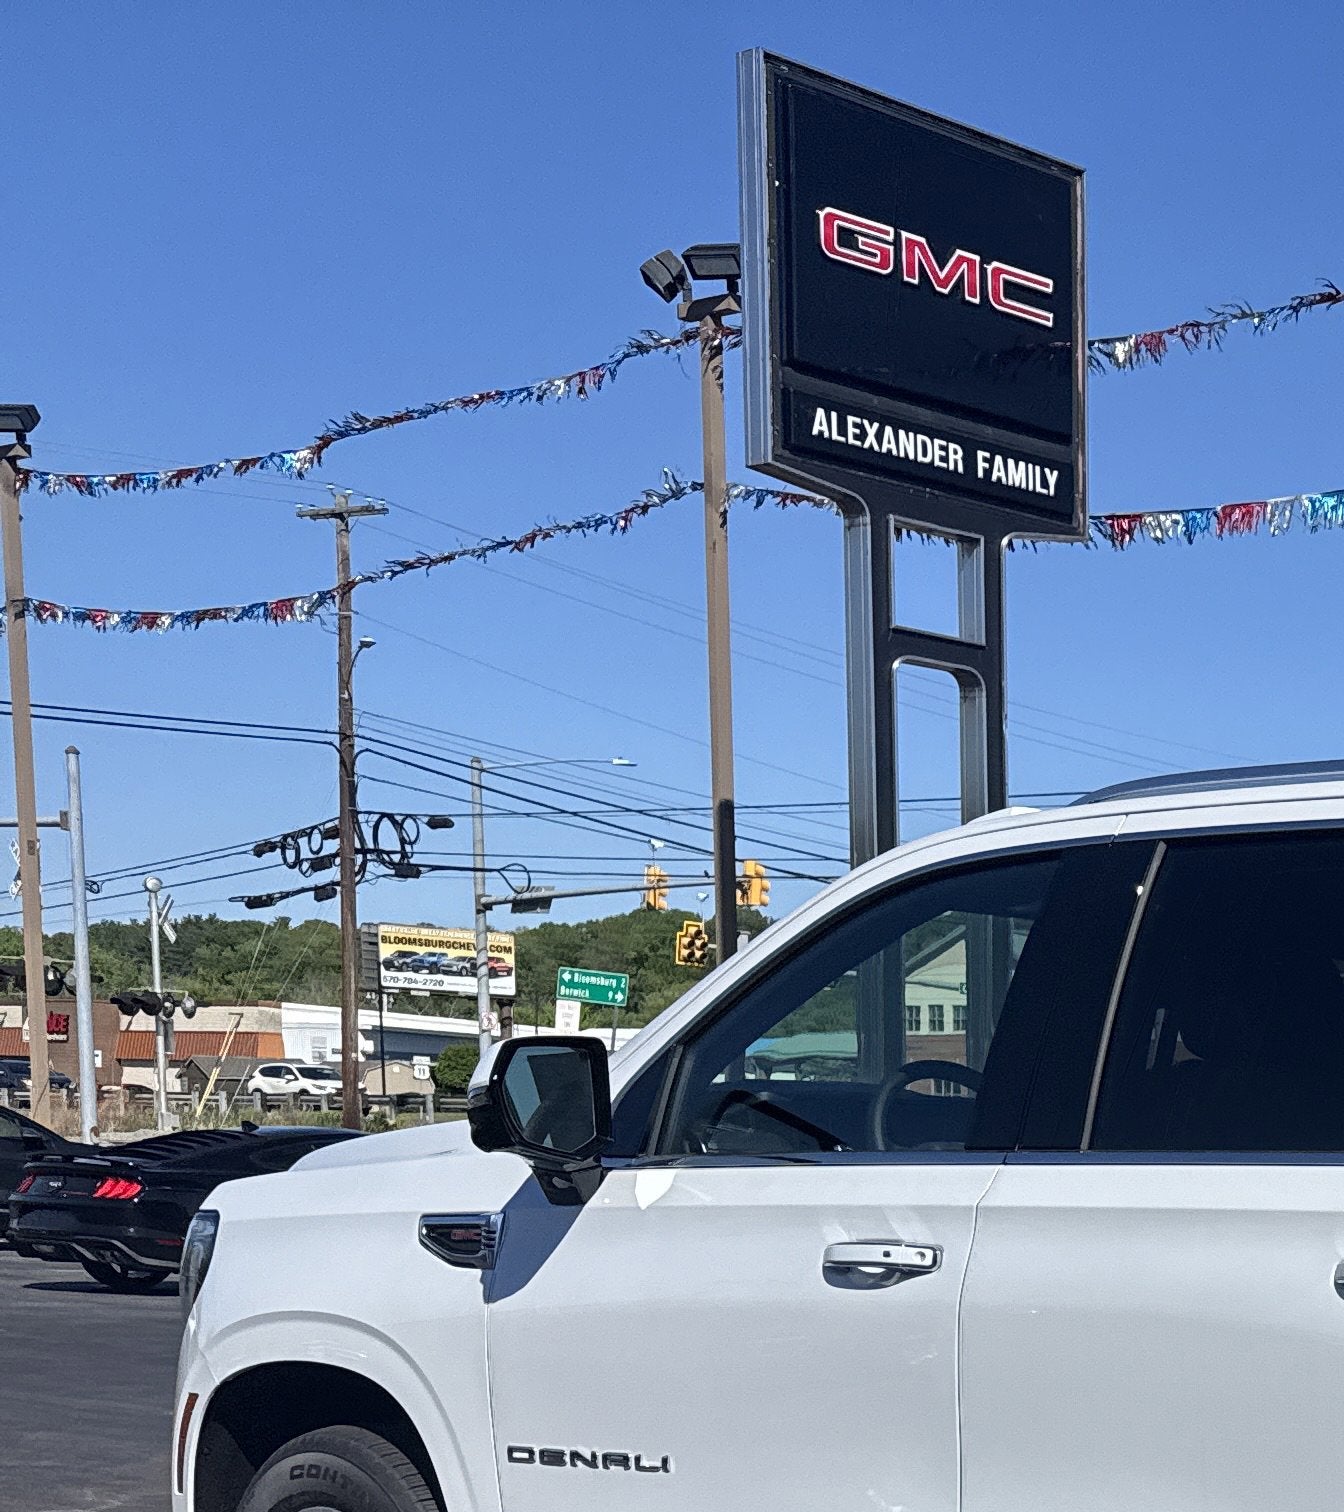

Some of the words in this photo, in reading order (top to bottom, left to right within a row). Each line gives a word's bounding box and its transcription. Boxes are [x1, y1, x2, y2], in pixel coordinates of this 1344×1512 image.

[816, 206, 1054, 328] GMC
[811, 407, 964, 475] ALEXANDER
[977, 450, 1059, 498] FAMILY
[620, 977, 626, 989] 2
[506, 1444, 671, 1474] DENALI
